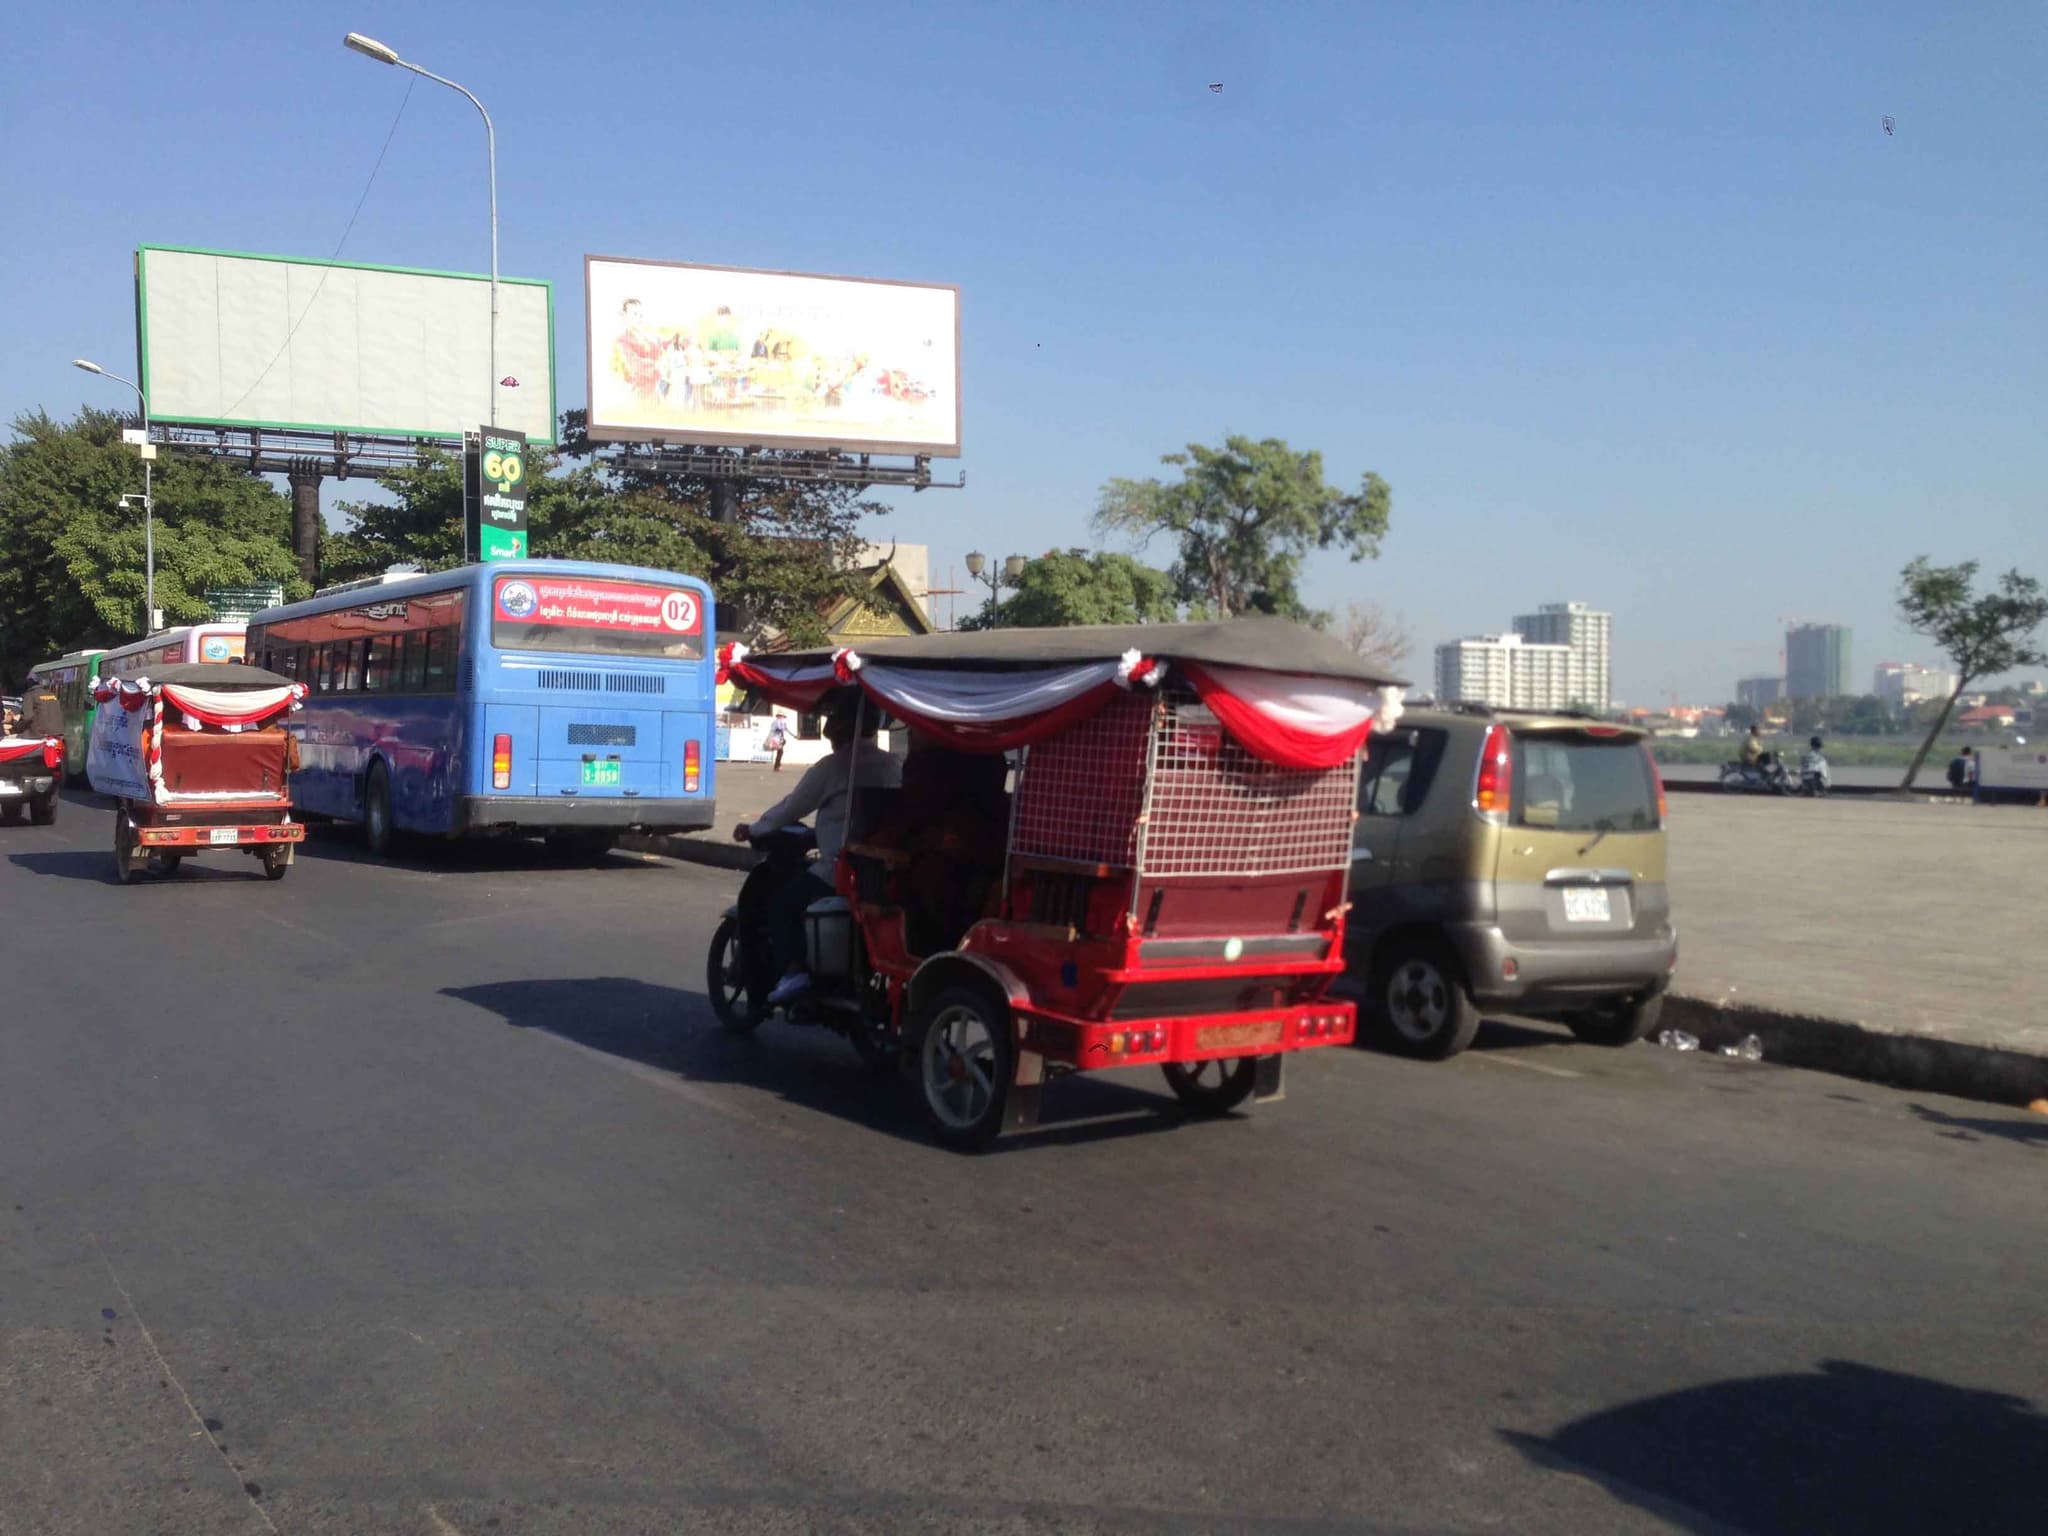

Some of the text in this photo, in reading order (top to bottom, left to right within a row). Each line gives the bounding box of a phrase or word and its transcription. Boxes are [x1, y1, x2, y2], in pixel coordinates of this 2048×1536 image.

[485, 436, 521, 453] SUPER
[485, 453, 521, 482] 60
[490, 545, 517, 559] Smart
[667, 599, 690, 622] 02
